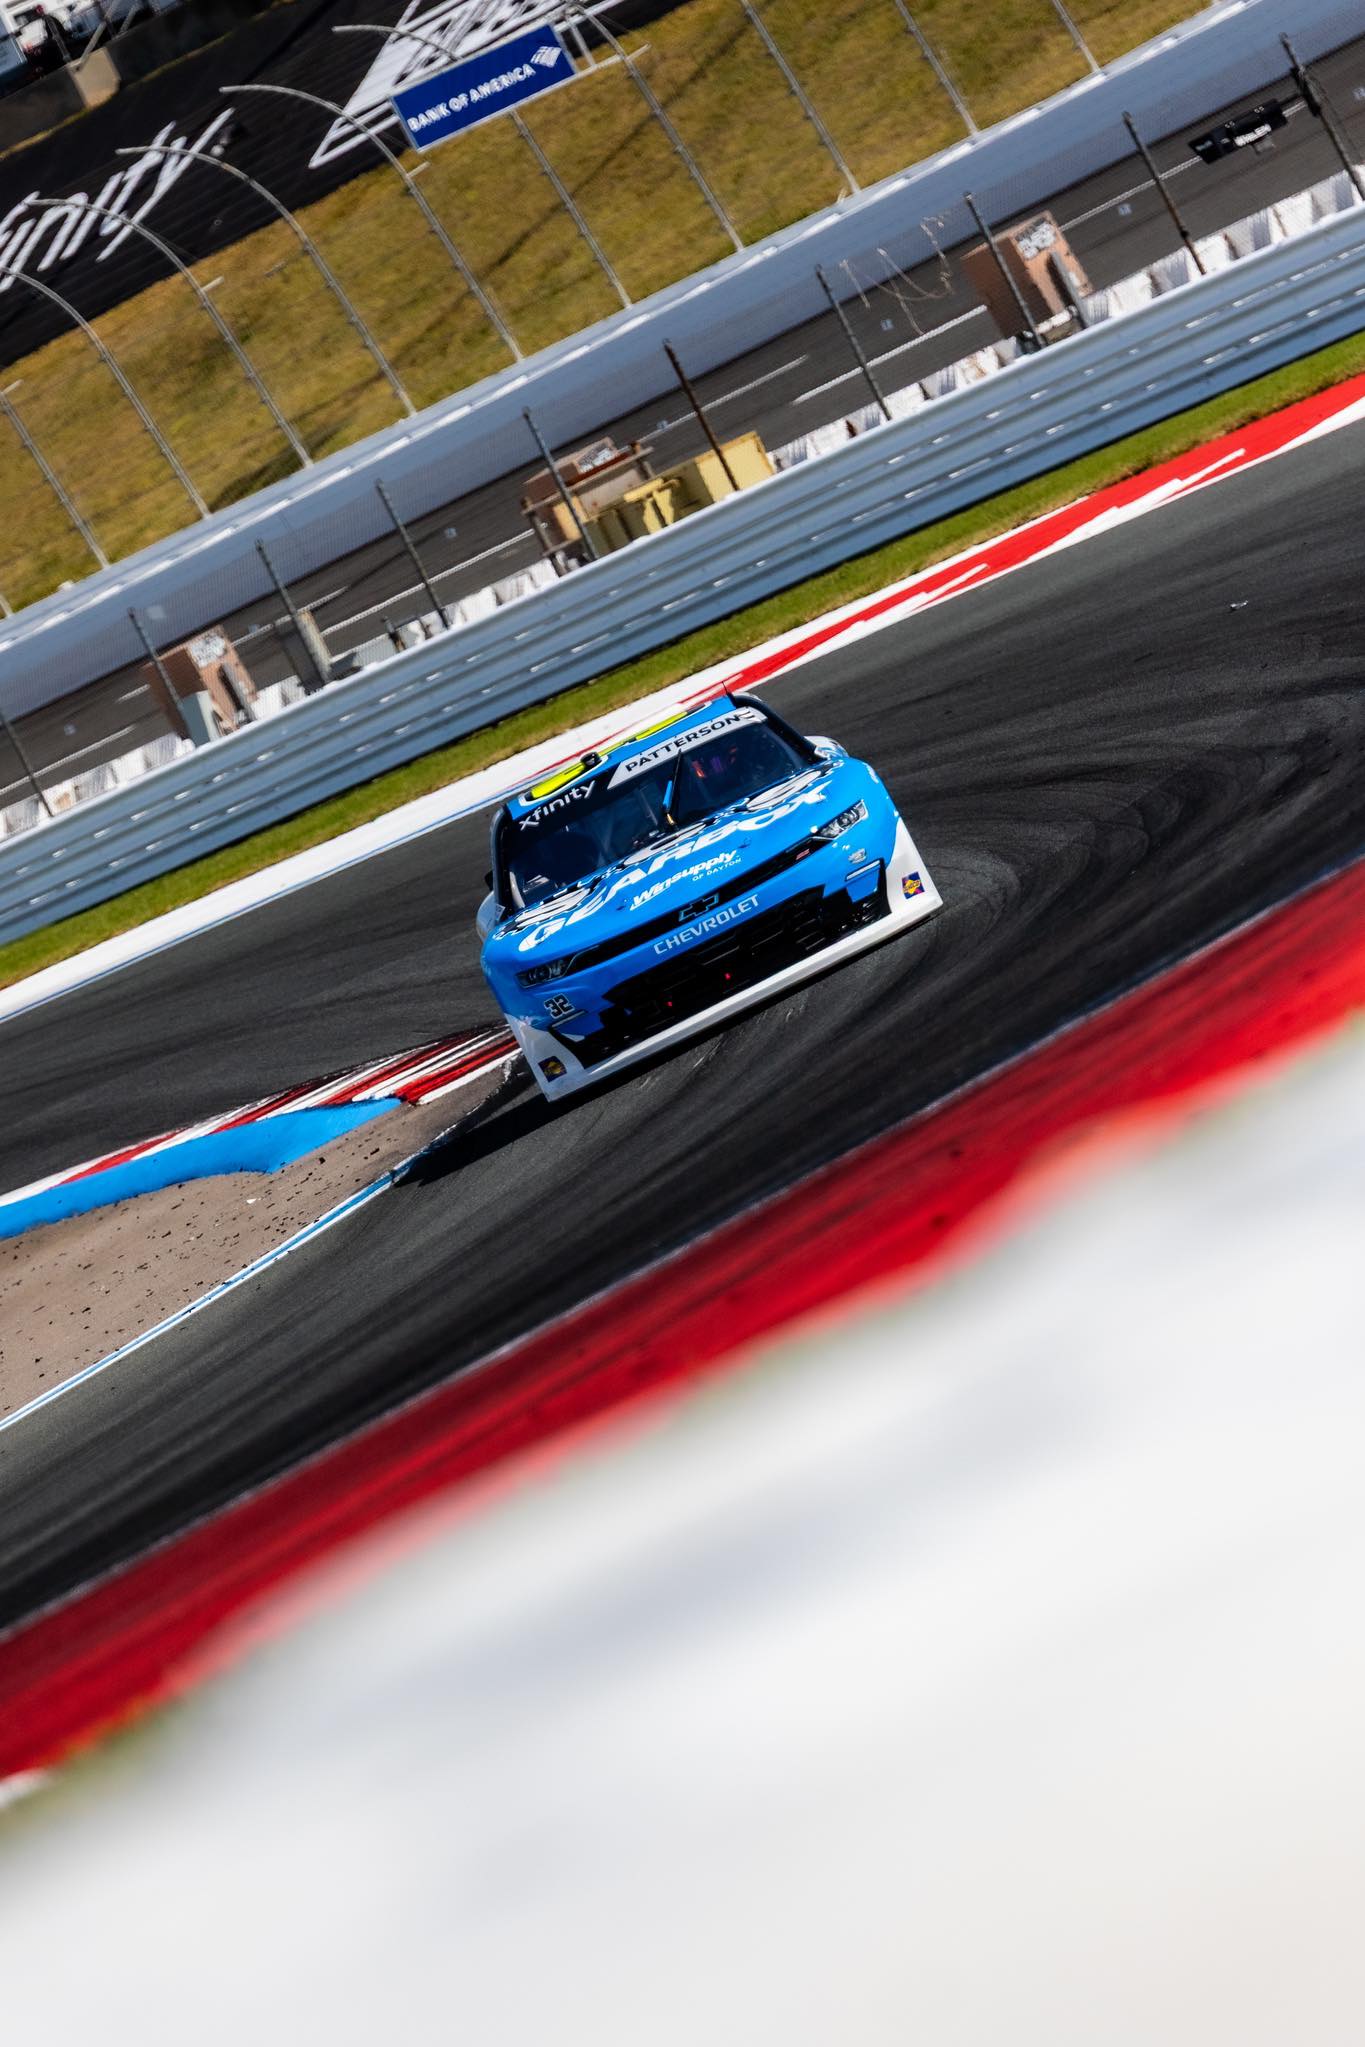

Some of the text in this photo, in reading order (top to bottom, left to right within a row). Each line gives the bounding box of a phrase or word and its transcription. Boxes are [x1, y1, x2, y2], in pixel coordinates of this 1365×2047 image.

[407, 63, 536, 132] BANK OF AMERICA
[625, 714, 741, 772] PATTERSON
[519, 780, 595, 831] xfinity
[518, 779, 833, 952] GEARBOX
[630, 850, 737, 911] Winsupply
[692, 858, 742, 882] OF DAYTON
[653, 894, 760, 955] CHEVROLET
[543, 993, 576, 1019] 32
